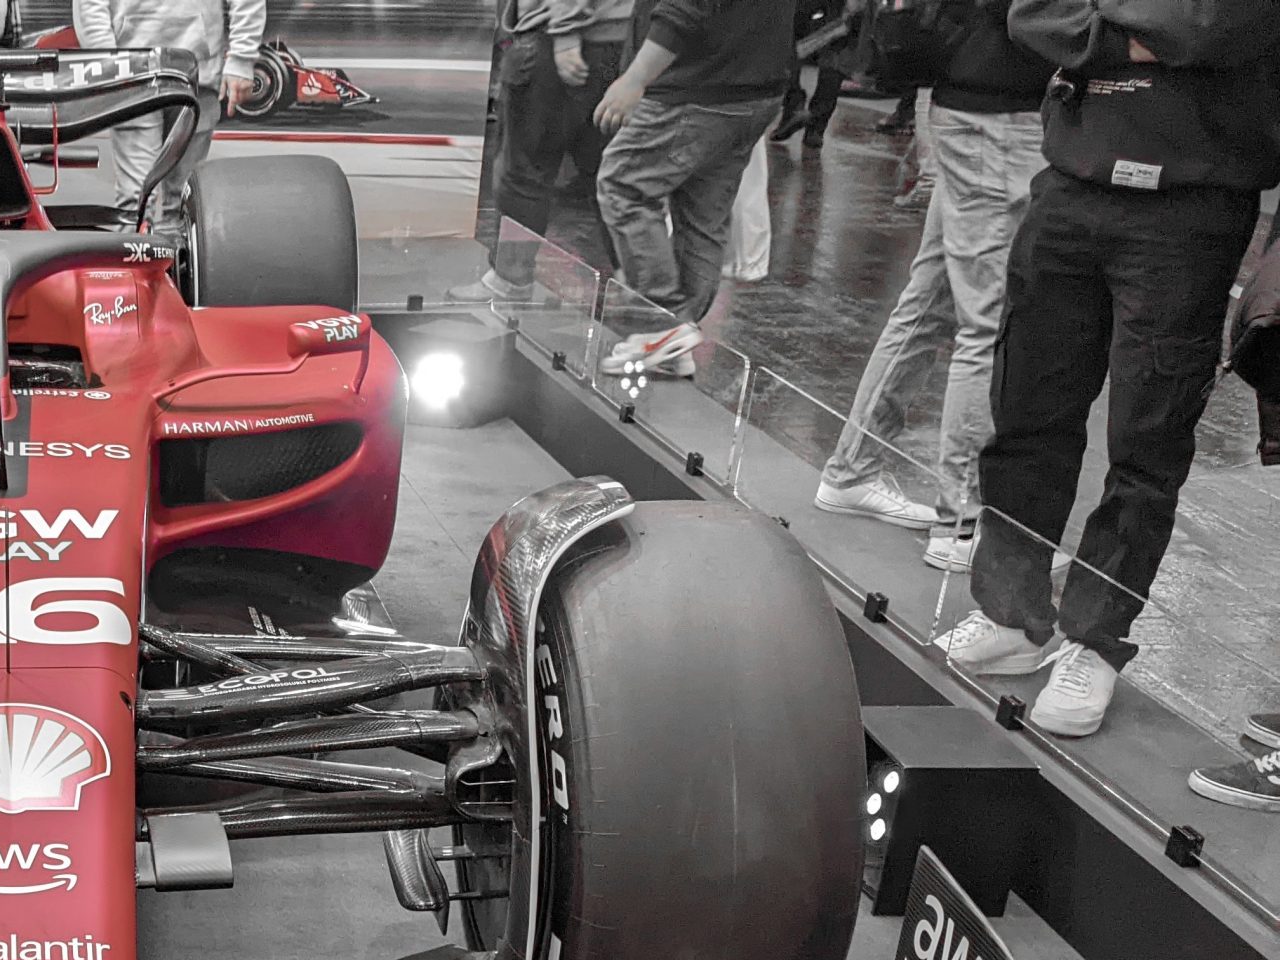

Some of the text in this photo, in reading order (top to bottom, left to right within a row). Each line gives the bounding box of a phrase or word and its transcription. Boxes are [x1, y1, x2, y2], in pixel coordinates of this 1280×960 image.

[294, 313, 363, 330] VGW
[326, 323, 359, 342] PLAY
[164, 413, 315, 435] HARMAN AUTOMOTIVE
[197, 667, 333, 694] ECOPOL
[536, 643, 569, 811] ERO
